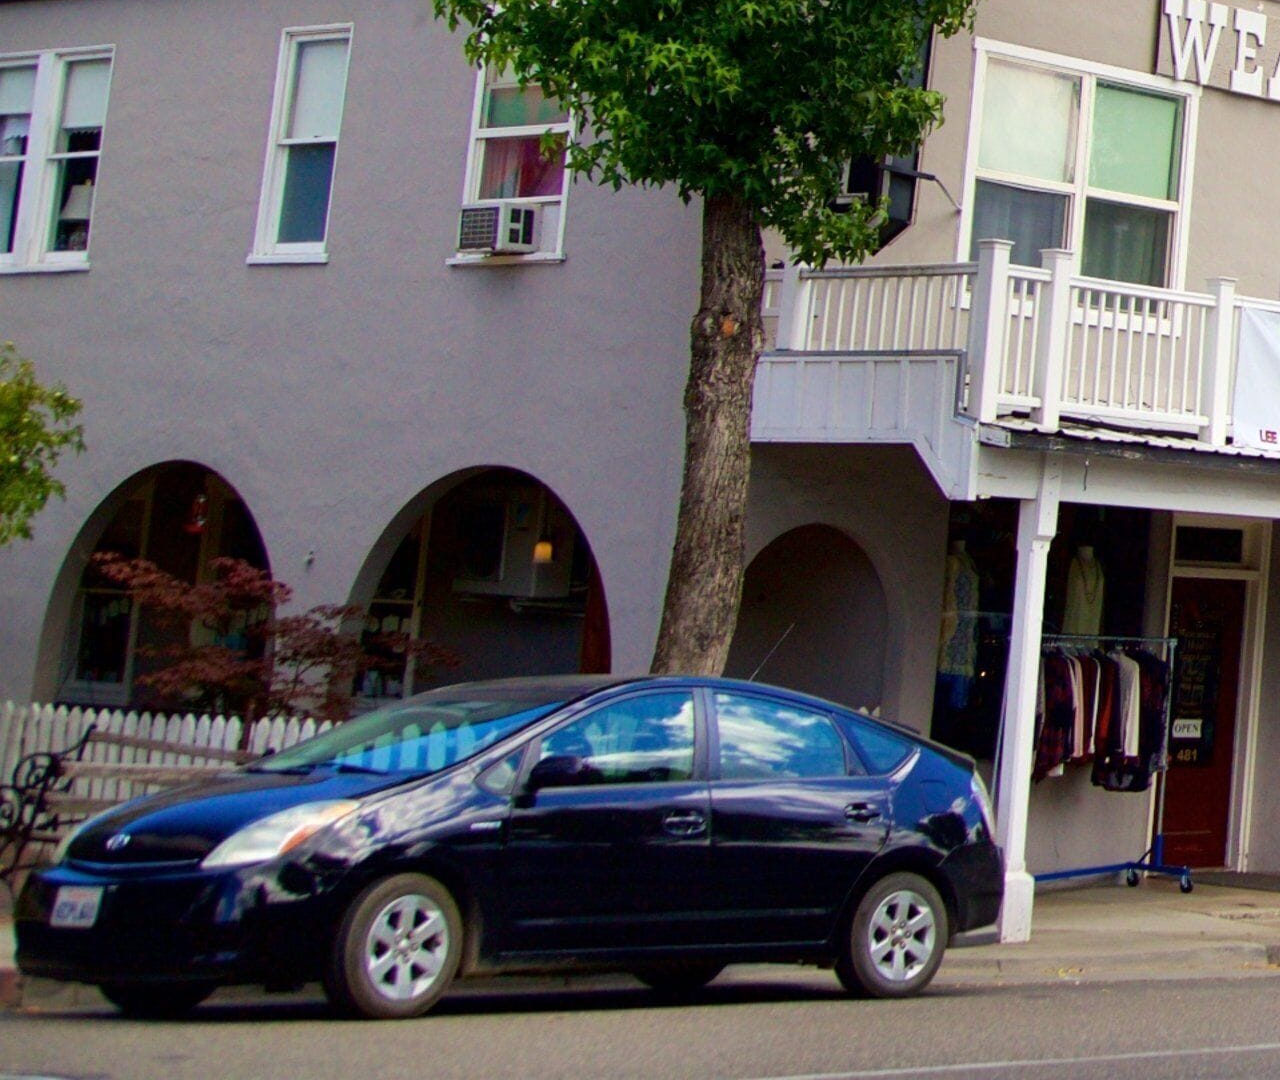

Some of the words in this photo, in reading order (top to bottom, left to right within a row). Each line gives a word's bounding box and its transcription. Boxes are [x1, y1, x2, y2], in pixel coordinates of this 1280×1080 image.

[1260, 429, 1278, 444] LEE
[1174, 723, 1198, 734] OPEN
[1176, 749, 1198, 762] 481
